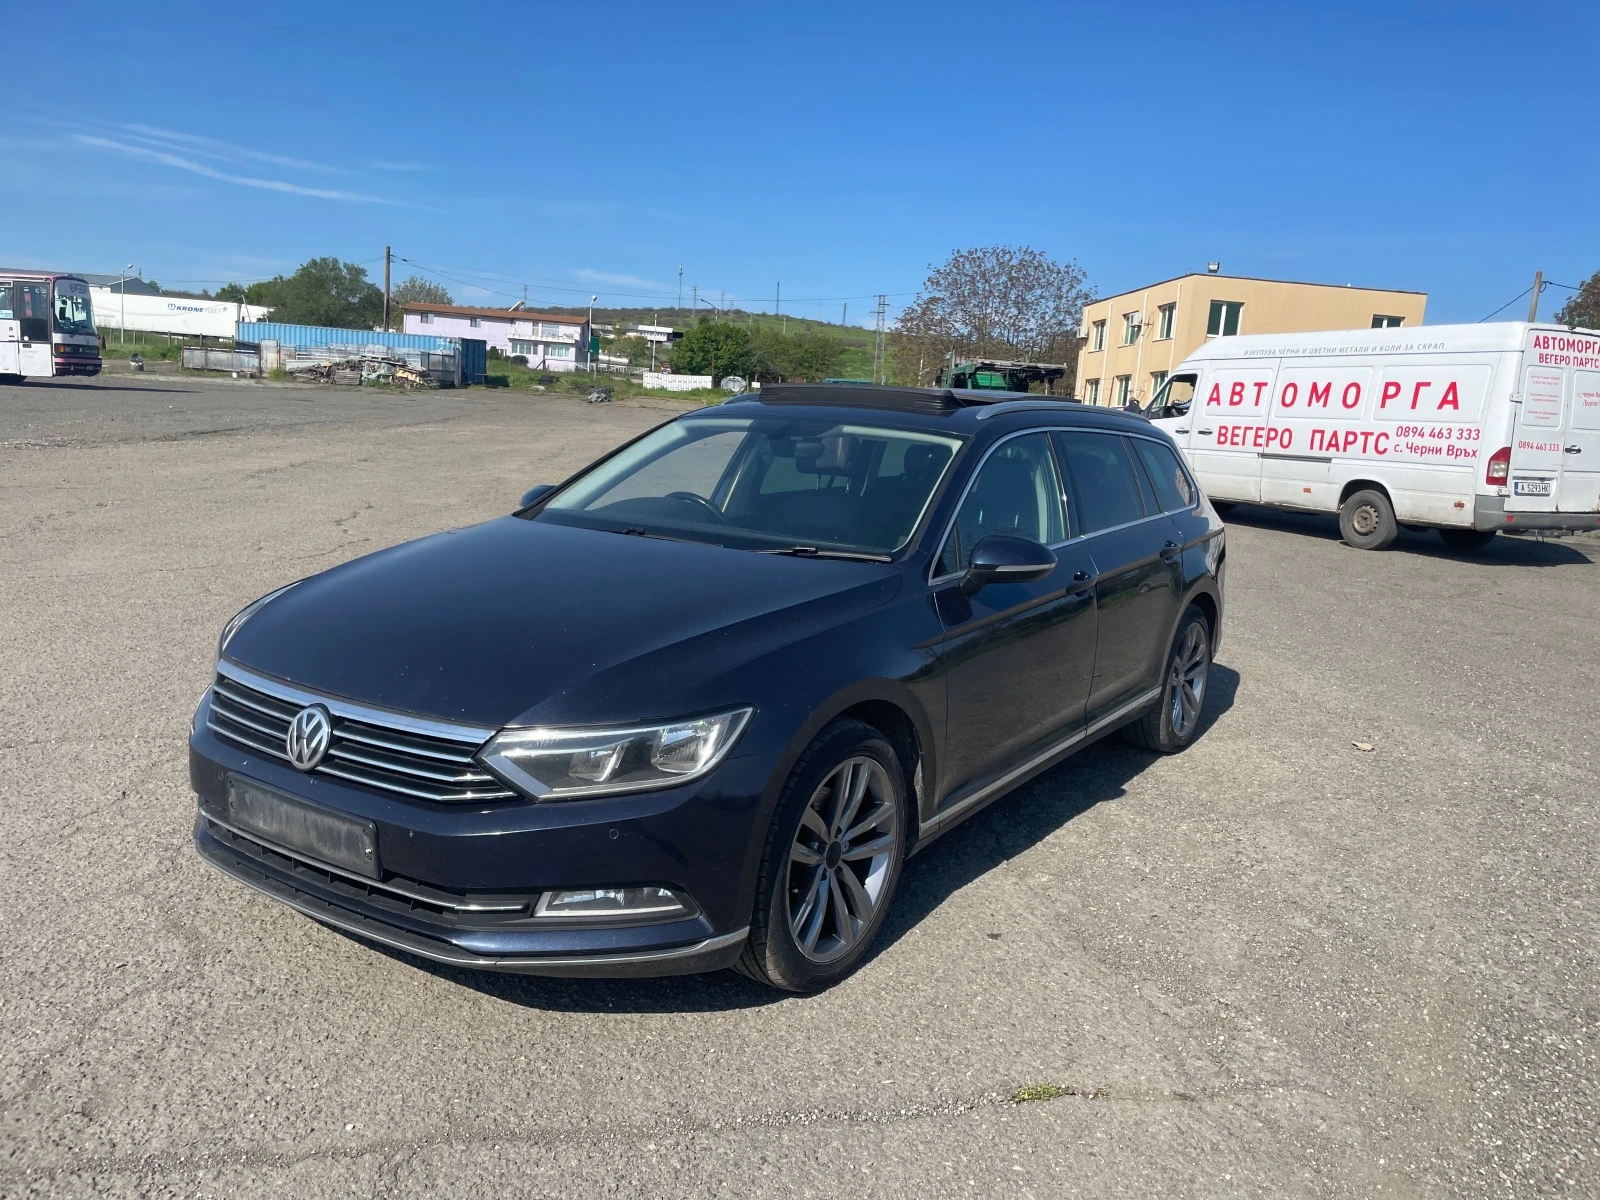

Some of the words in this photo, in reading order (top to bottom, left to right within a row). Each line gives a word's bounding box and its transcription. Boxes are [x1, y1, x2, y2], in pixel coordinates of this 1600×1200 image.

[1279, 347, 1300, 355] ЧЕРНИ
[1308, 346, 1337, 355] ЦВЕТНИ
[1338, 345, 1369, 354] МЕТАЛИ
[1379, 344, 1401, 352] КОЛИ
[1404, 343, 1414, 351] ЗА
[1416, 342, 1445, 350] СКРАП
[1538, 353, 1571, 366] ВЕГЕРО
[1572, 356, 1600, 369] ПАРТС
[1206, 381, 1460, 411] АВТОМОРГА
[1216, 425, 1293, 449] ВЕГЕРО
[1309, 429, 1390, 455] ПАРТС
[1396, 426, 1425, 438] 0894
[1429, 427, 1452, 440] 463
[1456, 428, 1480, 441] 333
[1405, 441, 1442, 457] Черни
[1446, 444, 1478, 460] Връх
[1518, 441, 1534, 450] 0894
[1536, 442, 1547, 452] 463
[1549, 443, 1559, 452] 333
